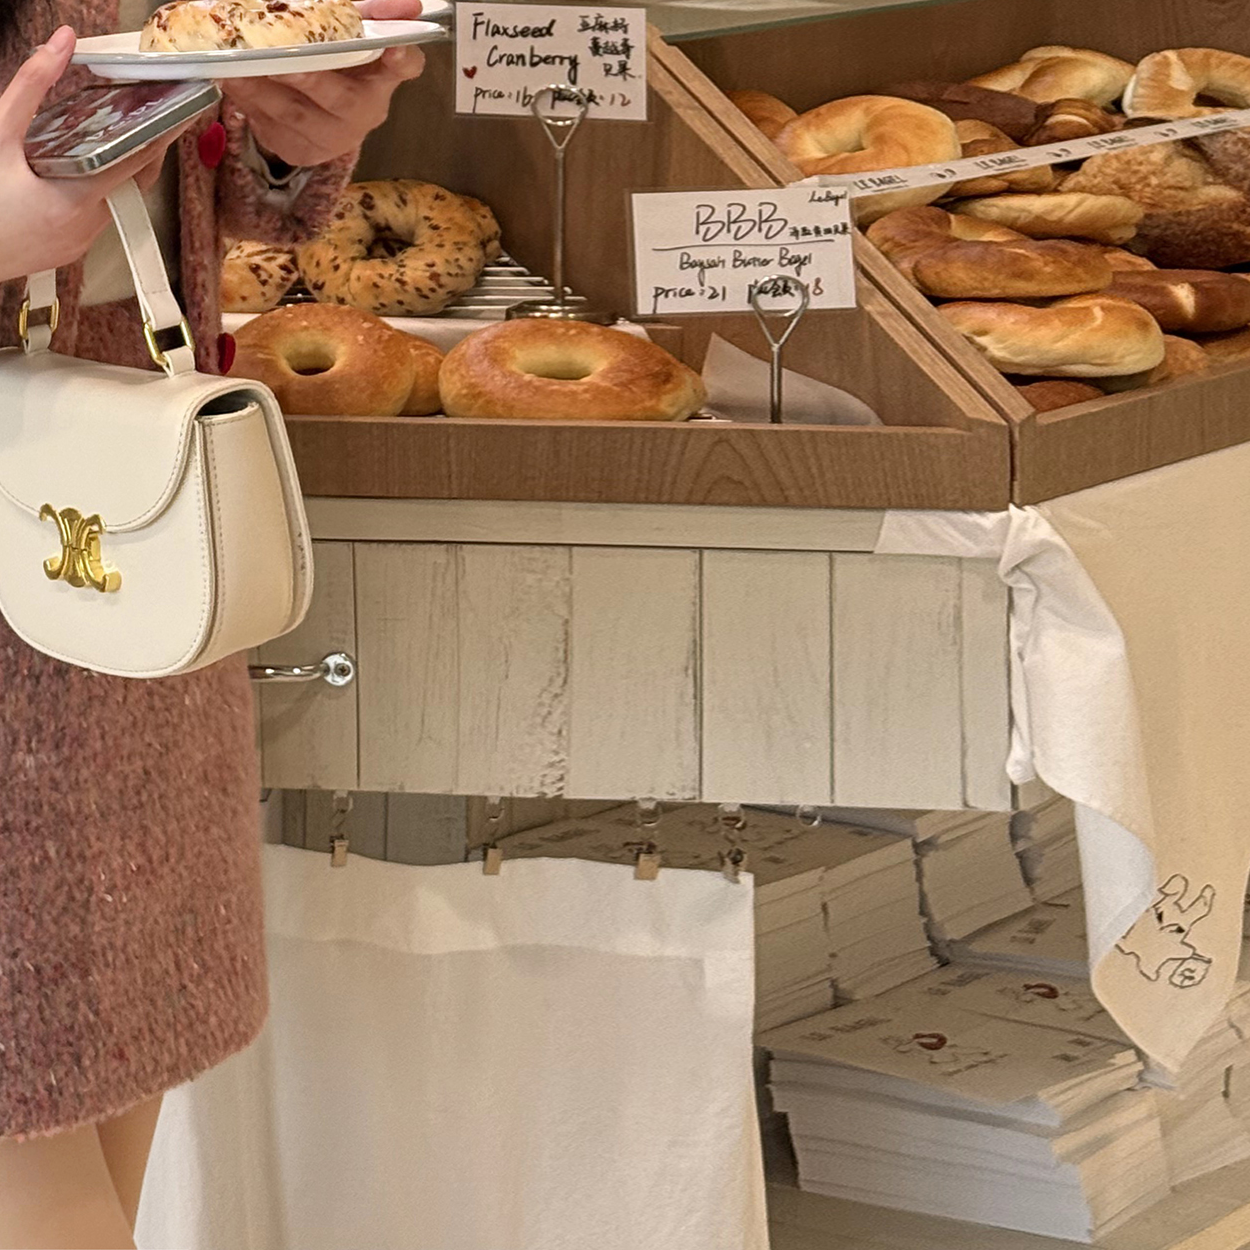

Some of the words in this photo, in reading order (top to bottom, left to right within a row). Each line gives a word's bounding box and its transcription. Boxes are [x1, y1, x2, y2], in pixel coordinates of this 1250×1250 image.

[472, 12, 556, 40] Flaxseed
[486, 45, 582, 86] Cranberry
[974, 160, 991, 171] LE
[854, 180, 870, 191] LE
[869, 174, 908, 188] BAGEL
[695, 202, 789, 242] BBB
[732, 249, 774, 270] Butter
[778, 246, 812, 277] Bagel
